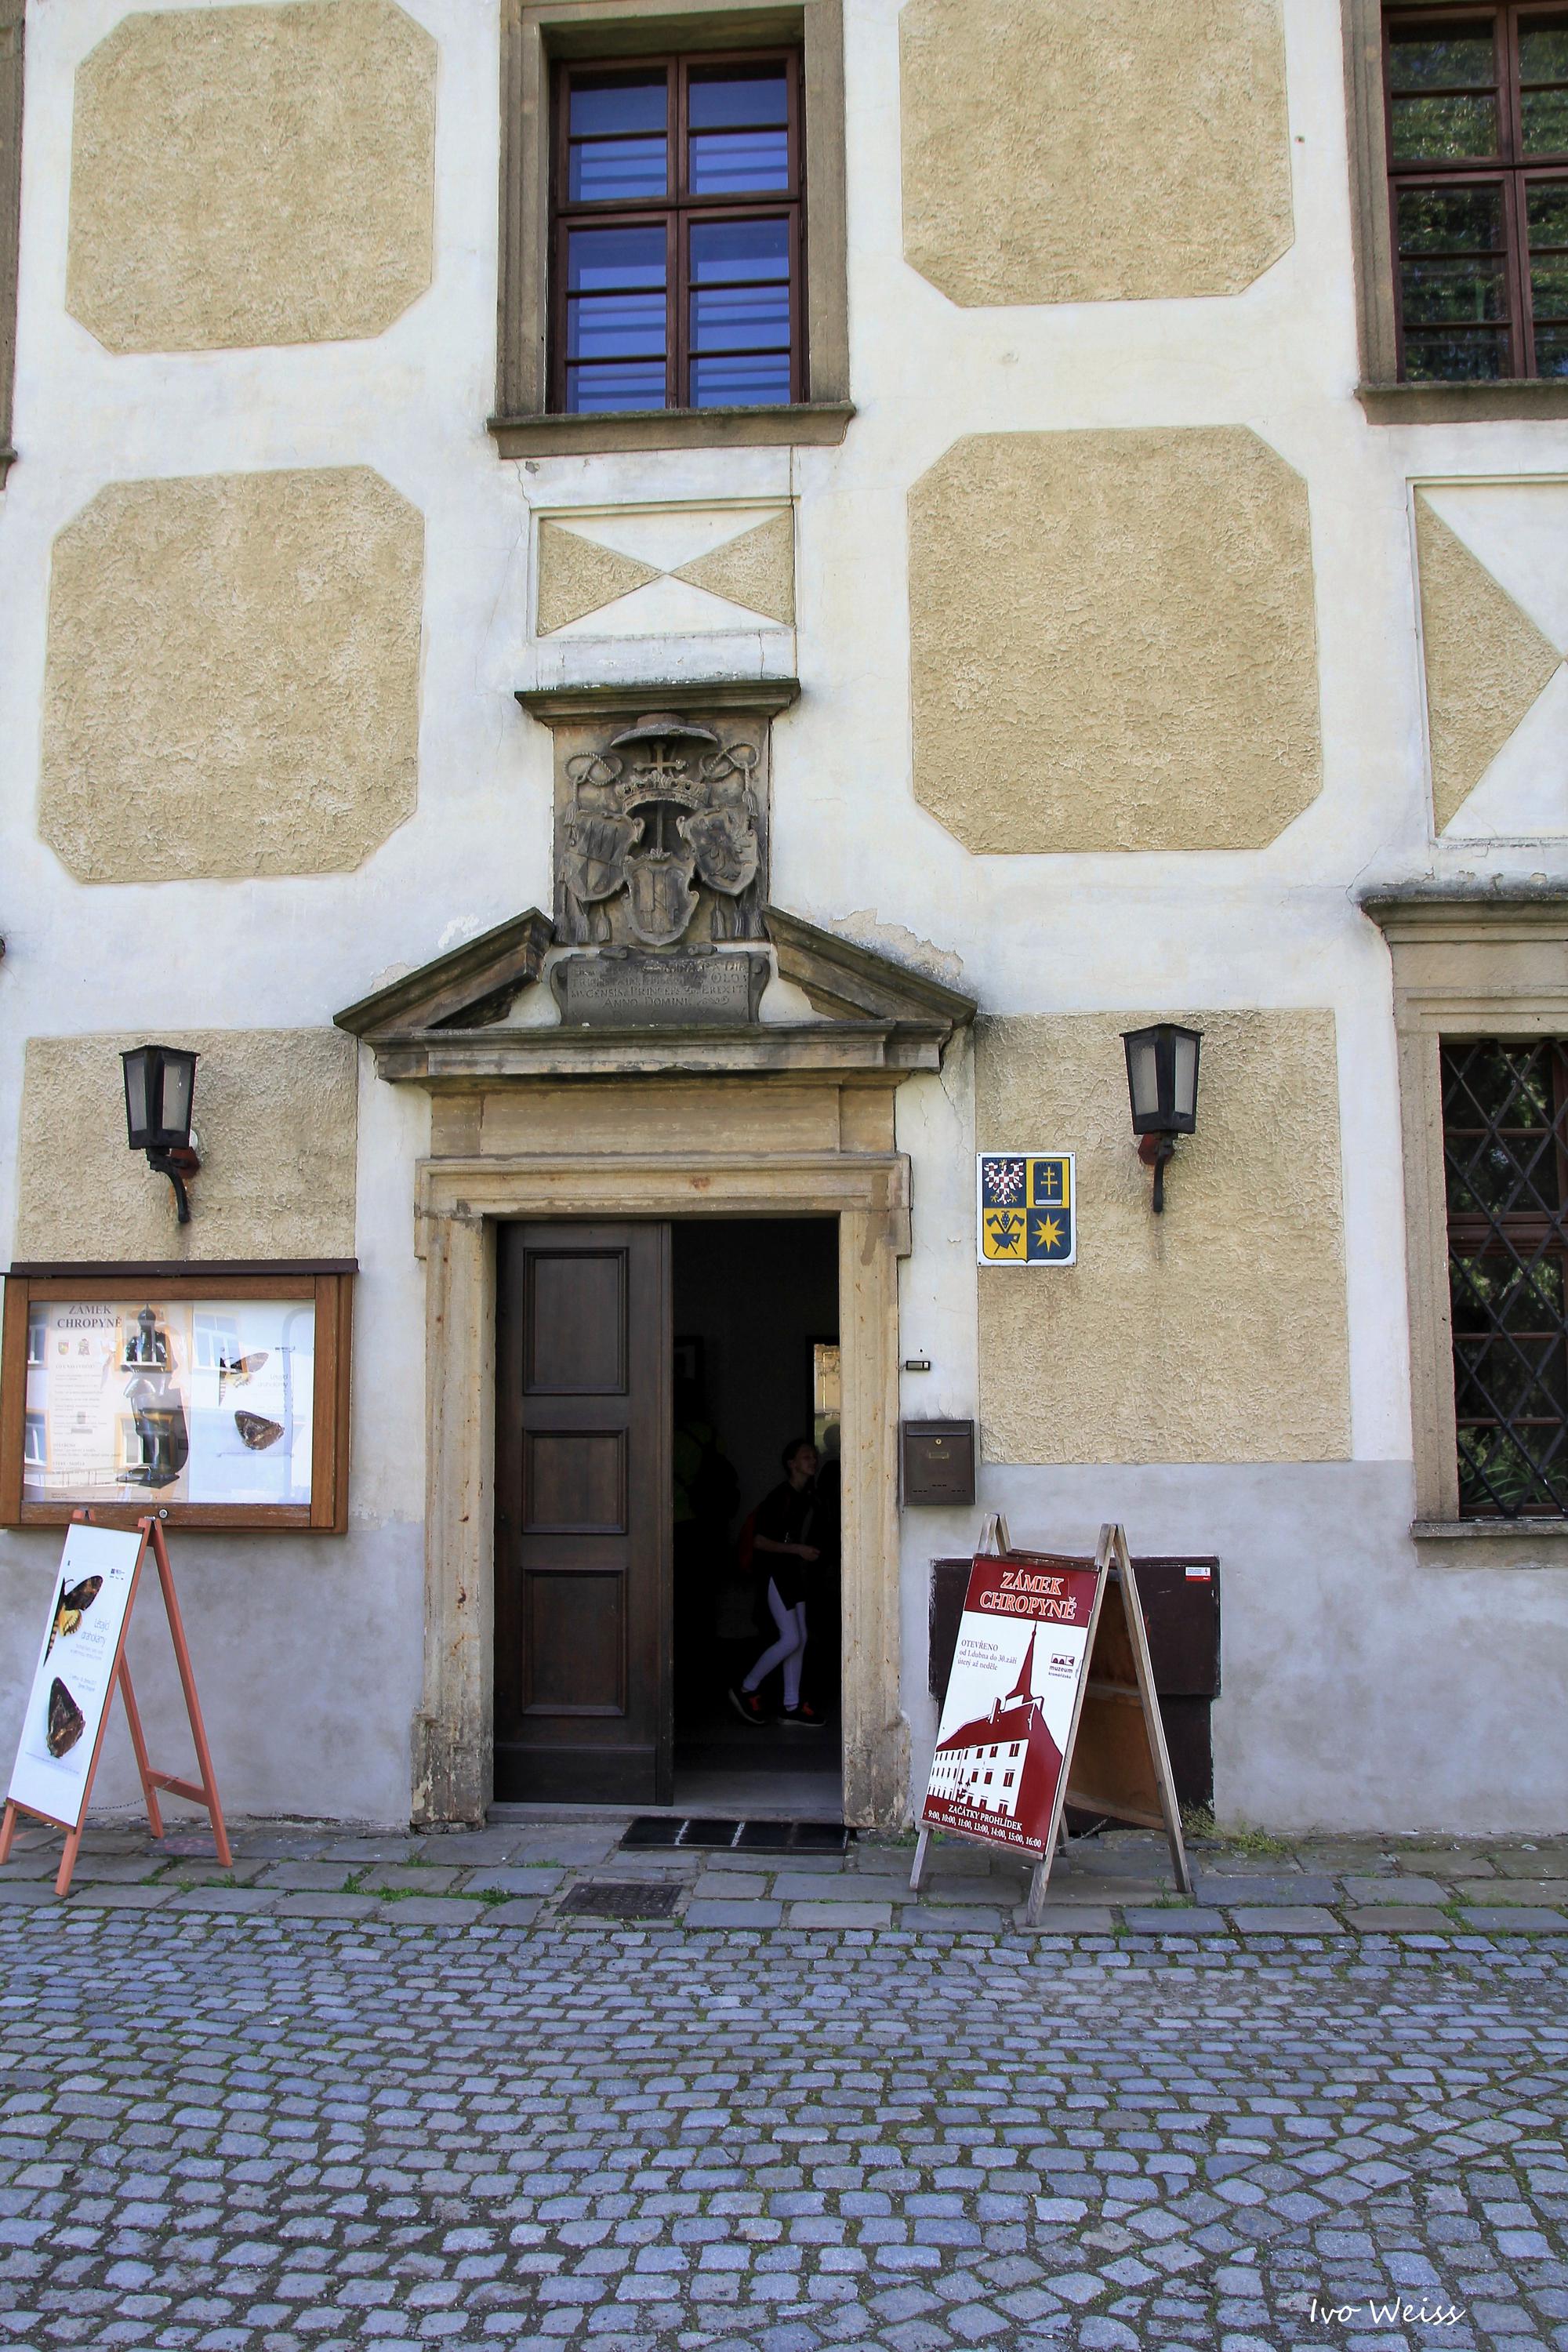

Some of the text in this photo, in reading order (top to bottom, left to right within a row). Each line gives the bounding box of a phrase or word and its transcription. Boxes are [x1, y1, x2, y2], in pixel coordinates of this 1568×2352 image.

[68, 1302, 112, 1315] ZÁMEK
[57, 1316, 122, 1328] CHROPYNĚ
[1000, 1569, 1065, 1596] ZÁMEK
[979, 1591, 1077, 1621] CHROPYNĚ
[961, 1639, 999, 1652] OTEVŘENO
[979, 1661, 998, 1671] neděle
[1049, 1665, 1073, 1674] muzeum
[948, 1804, 1023, 1831] ZAČÁTKY PROHLÍDEK
[927, 1809, 941, 1822] 9:00,
[942, 1813, 956, 1827] 10:00,
[957, 1817, 973, 1831] 11:00,
[990, 1827, 1007, 1840] 14:00,
[1025, 1836, 1042, 1848] 16:00
